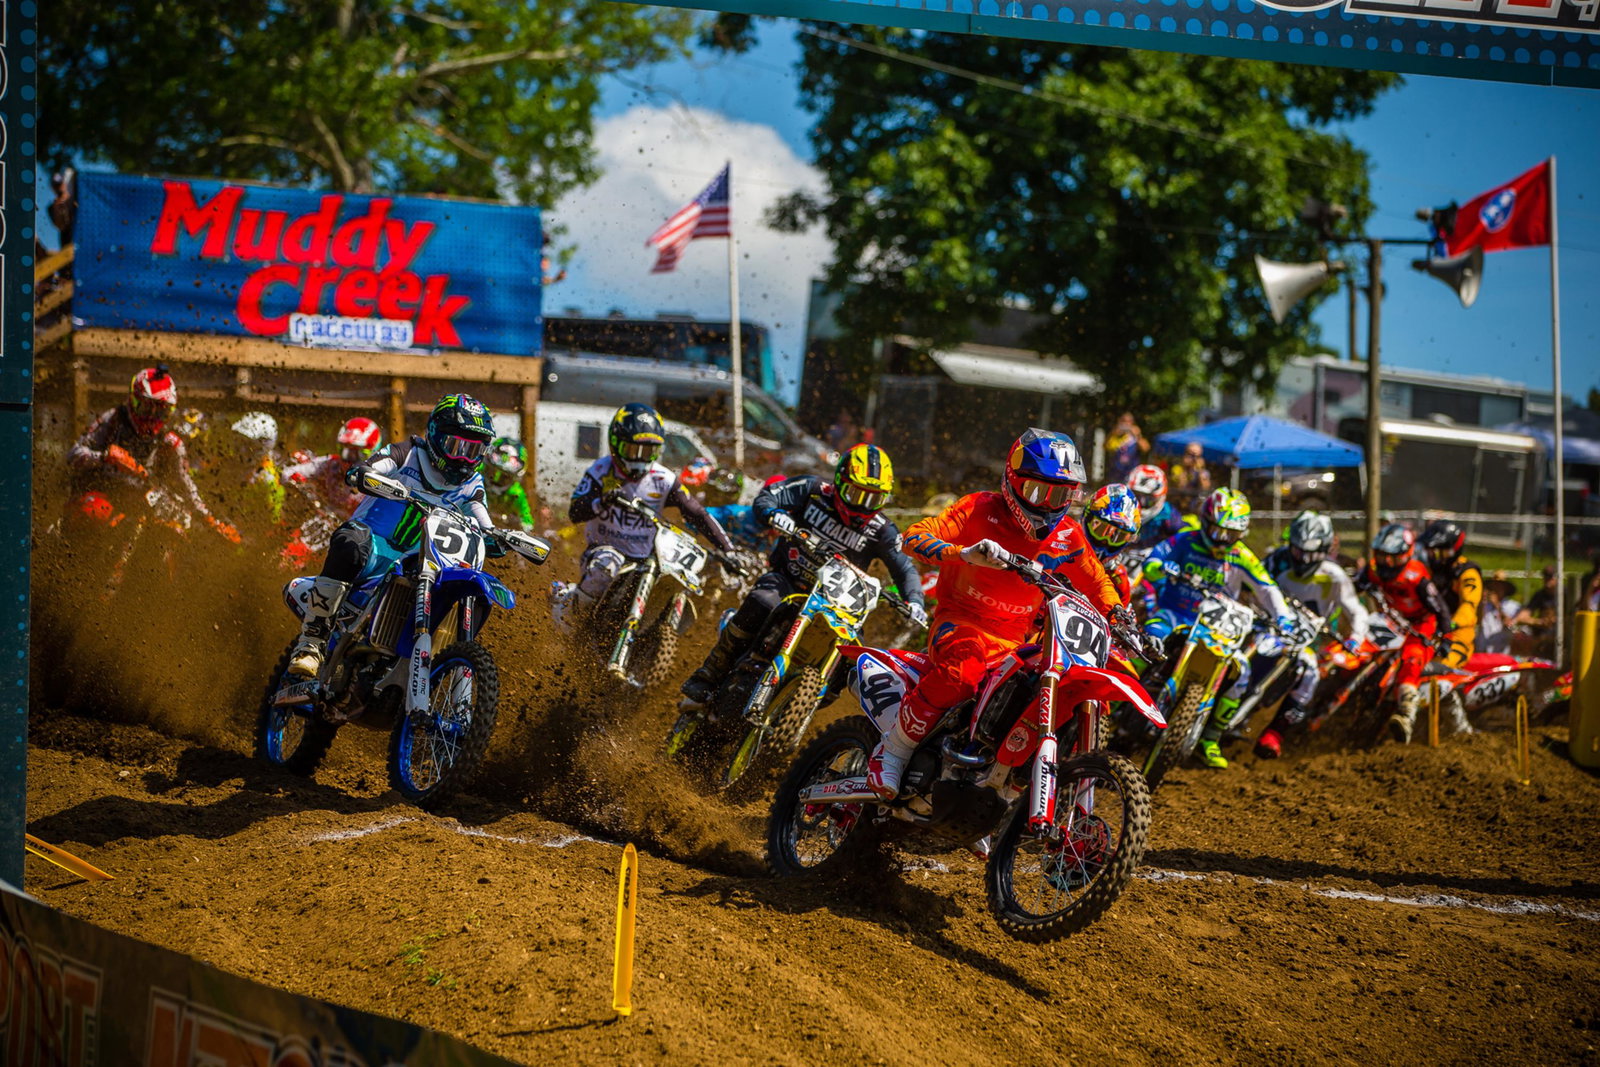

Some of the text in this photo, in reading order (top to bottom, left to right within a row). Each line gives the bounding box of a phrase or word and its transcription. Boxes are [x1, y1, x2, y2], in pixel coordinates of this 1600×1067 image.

[151, 181, 436, 280] Muddy
[236, 263, 470, 347] Creek
[433, 518, 480, 565] 51
[803, 504, 828, 528] FLY
[822, 517, 868, 553] RACING
[1014, 502, 1032, 533] Bull
[966, 585, 1034, 615] HONDA
[1063, 615, 1106, 669] 94
[411, 647, 421, 697] DUNLOP
[859, 672, 902, 719] 94
[1039, 765, 1050, 812] DUNLOP
